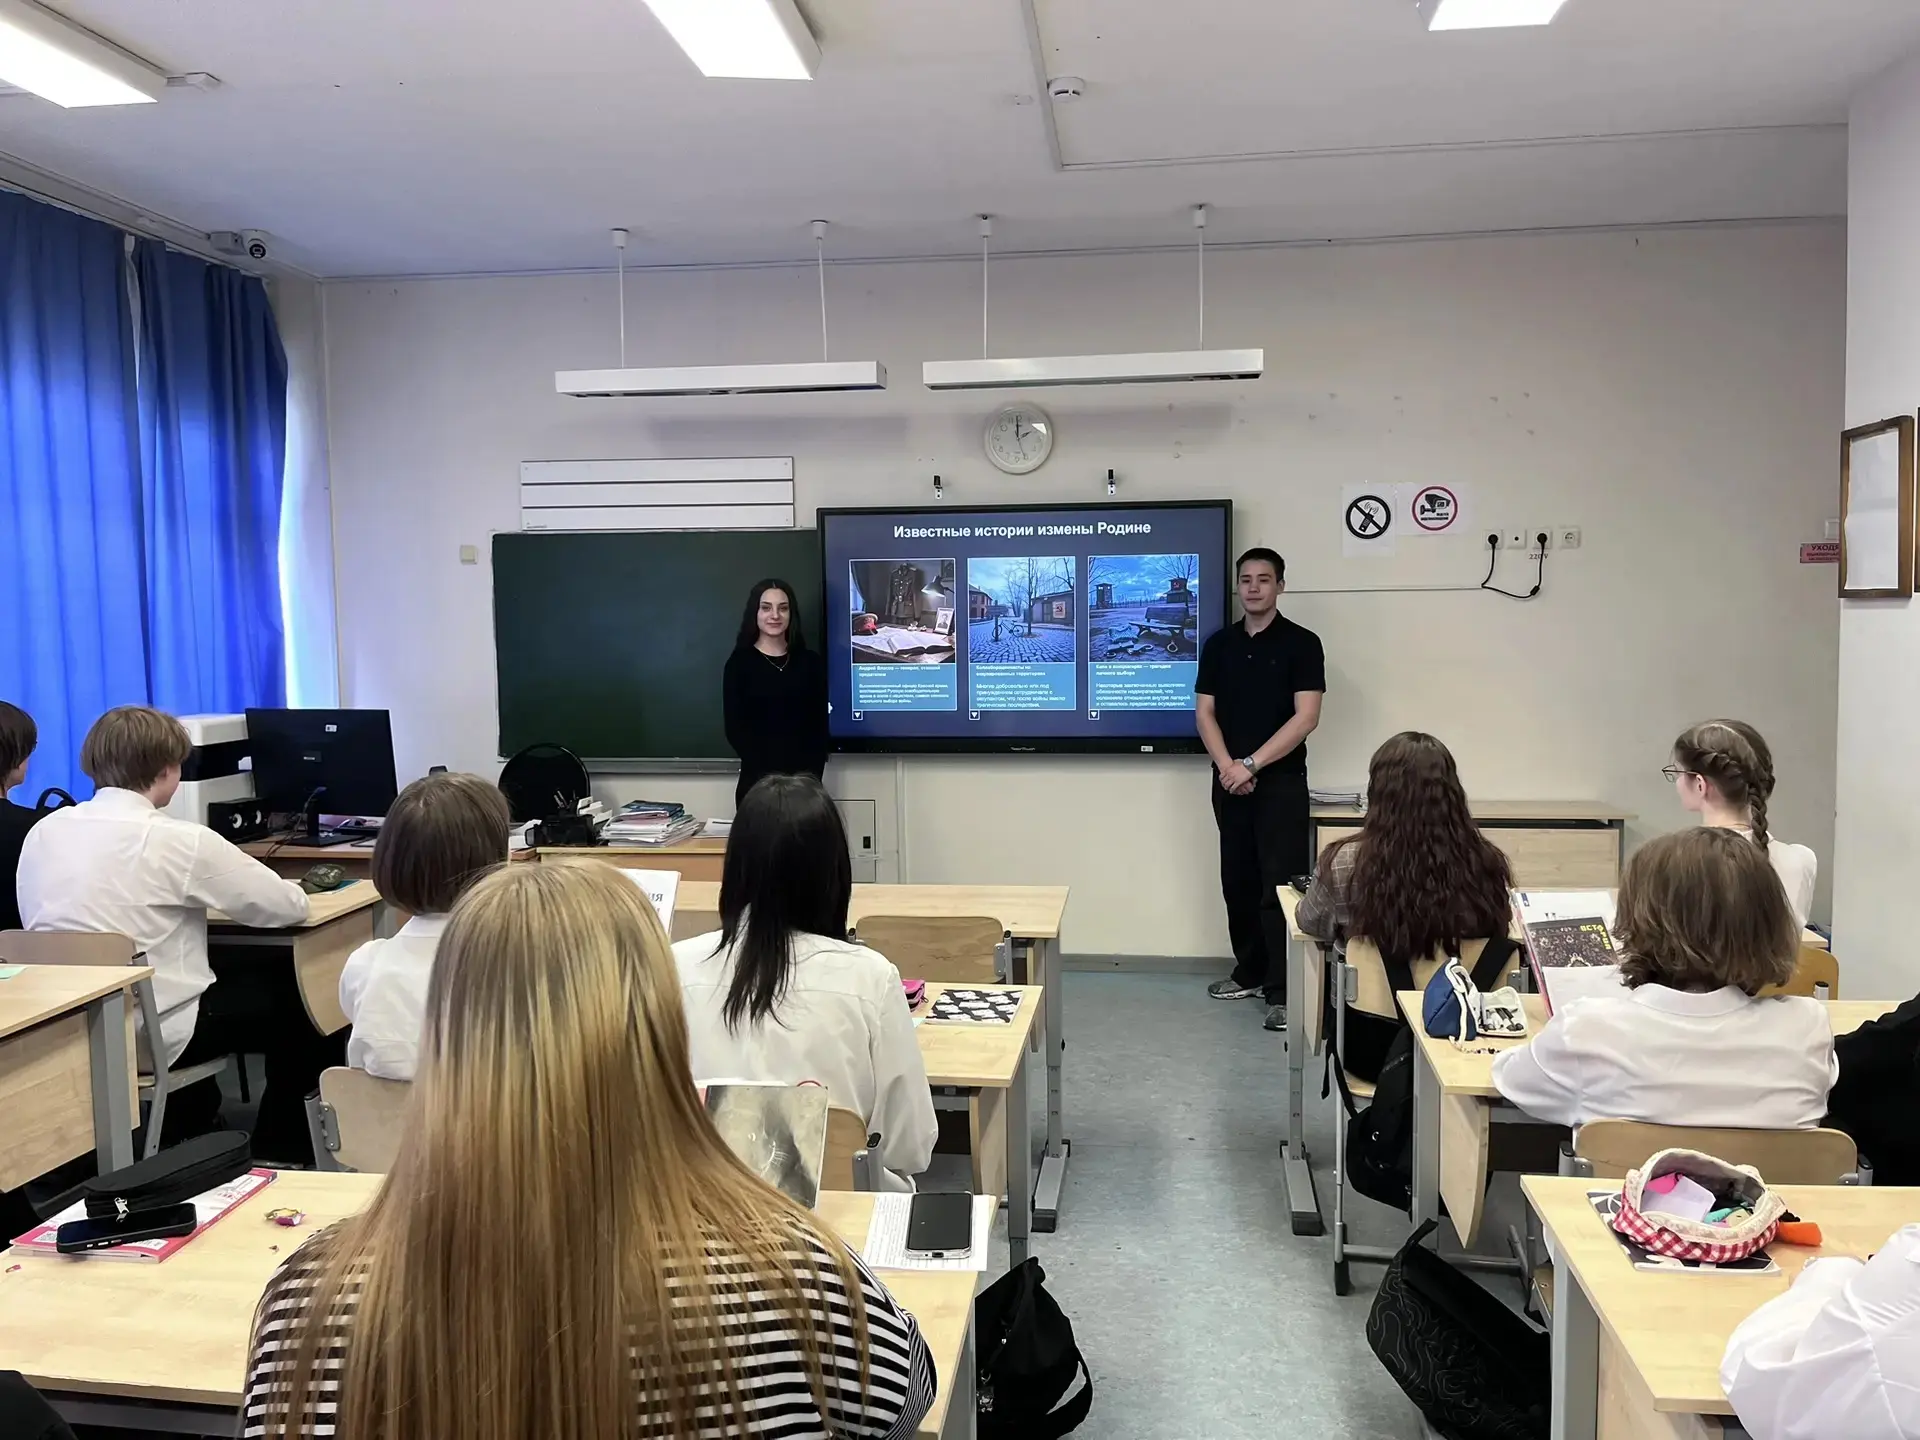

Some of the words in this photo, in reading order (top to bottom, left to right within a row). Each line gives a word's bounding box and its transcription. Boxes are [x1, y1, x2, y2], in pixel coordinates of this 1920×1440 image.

[894, 526, 971, 538] Известные
[974, 525, 1034, 539] истории
[1037, 525, 1093, 536] измены
[1098, 522, 1151, 536] Родине
